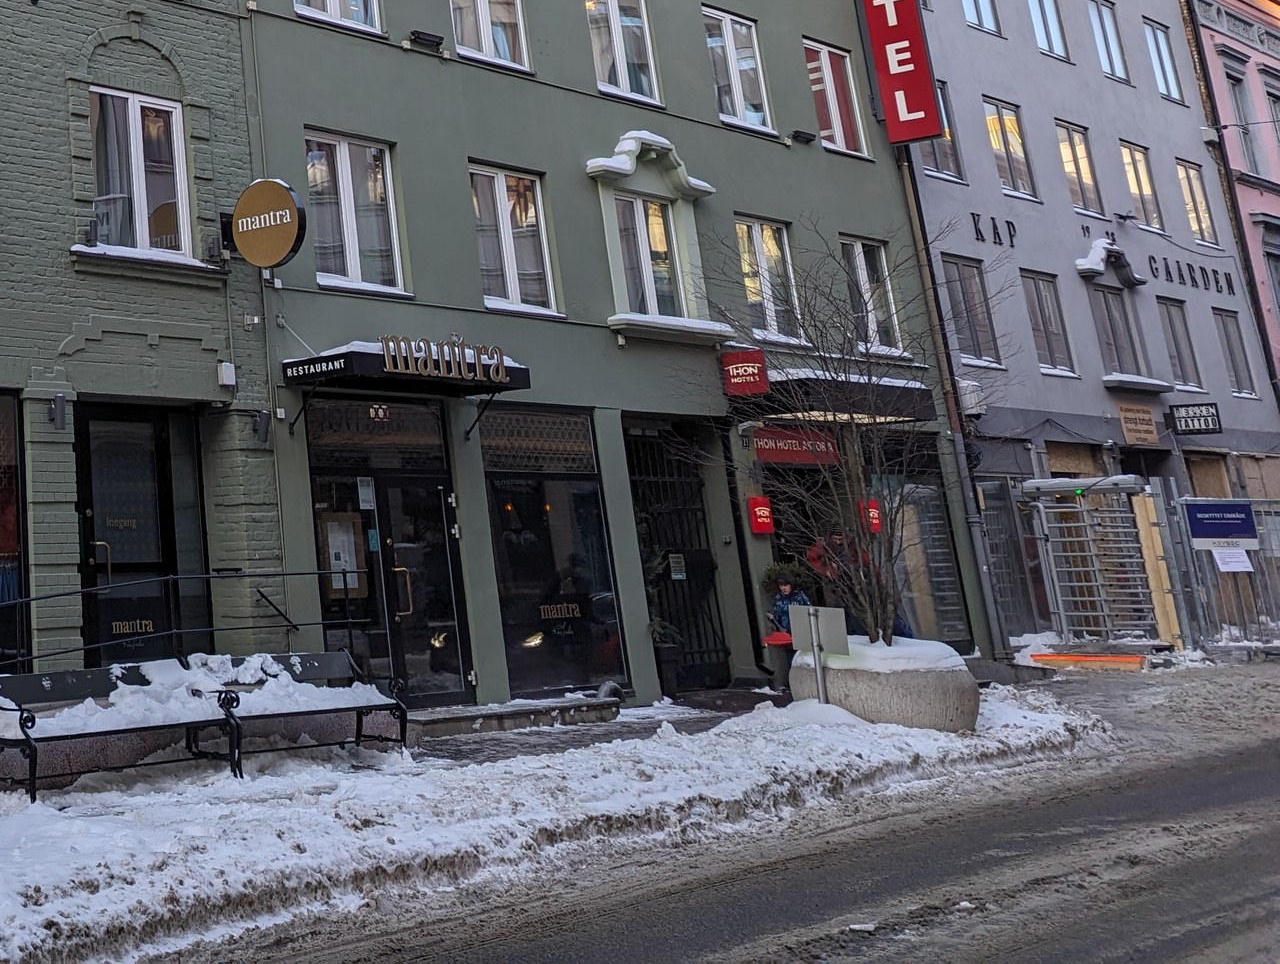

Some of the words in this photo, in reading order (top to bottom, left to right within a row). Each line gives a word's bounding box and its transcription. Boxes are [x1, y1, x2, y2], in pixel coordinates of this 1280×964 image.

[237, 207, 293, 234] mantra
[970, 212, 1017, 248] KAP
[1148, 254, 1236, 296] GAARDEN
[379, 334, 510, 384] mantra
[286, 358, 346, 377] RESTAURANT
[724, 363, 762, 376] THON
[731, 376, 760, 384] HOTELS
[1173, 405, 1217, 417] WERKEN
[1177, 417, 1218, 429] TATTOO
[753, 438, 776, 451] THON
[776, 439, 801, 451] HOTEL
[106, 517, 137, 529] Inngang
[539, 603, 581, 619] mantra
[111, 619, 154, 634] mantra
